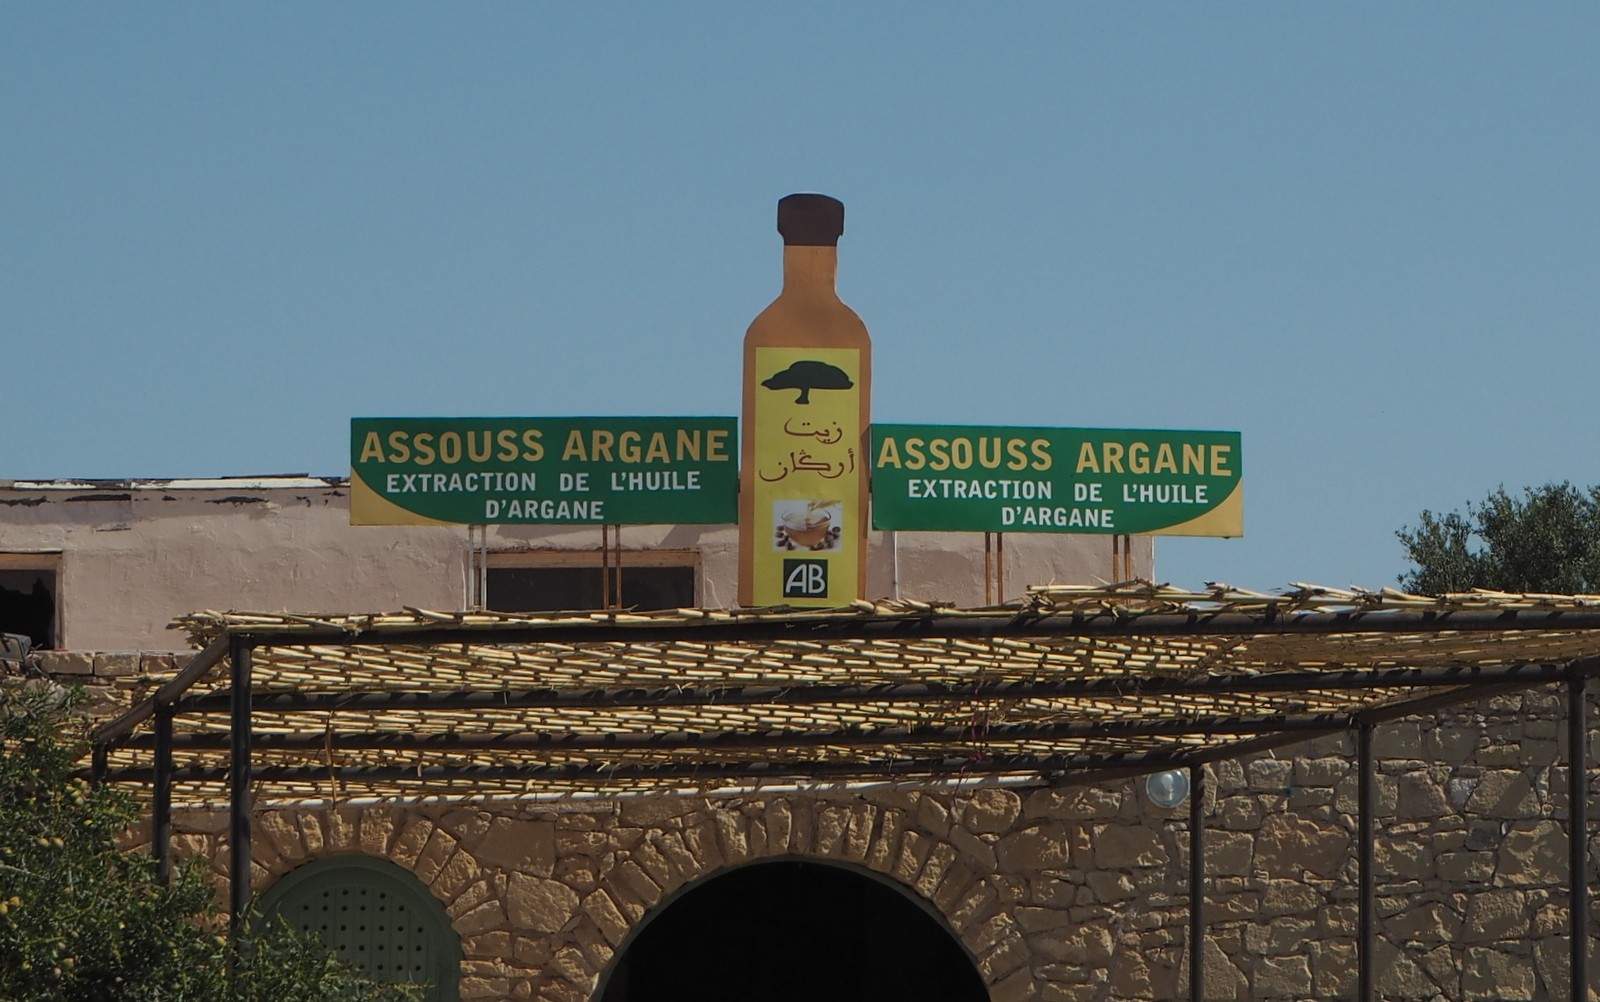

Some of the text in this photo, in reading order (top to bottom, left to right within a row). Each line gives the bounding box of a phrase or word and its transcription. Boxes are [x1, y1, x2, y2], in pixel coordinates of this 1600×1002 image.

[784, 417, 843, 445] زيت
[360, 429, 730, 465] ASSOUSS ARGANE
[877, 437, 1232, 477] ASSOUSS ARGANE
[386, 471, 701, 493] EXTRACTION DE L'HUILE
[908, 479, 1209, 504] EXTRACTION DE L'HUILE
[485, 500, 605, 520] D'ARGANE
[1002, 507, 1115, 528] D'ARGANE
[785, 563, 826, 594] AB
